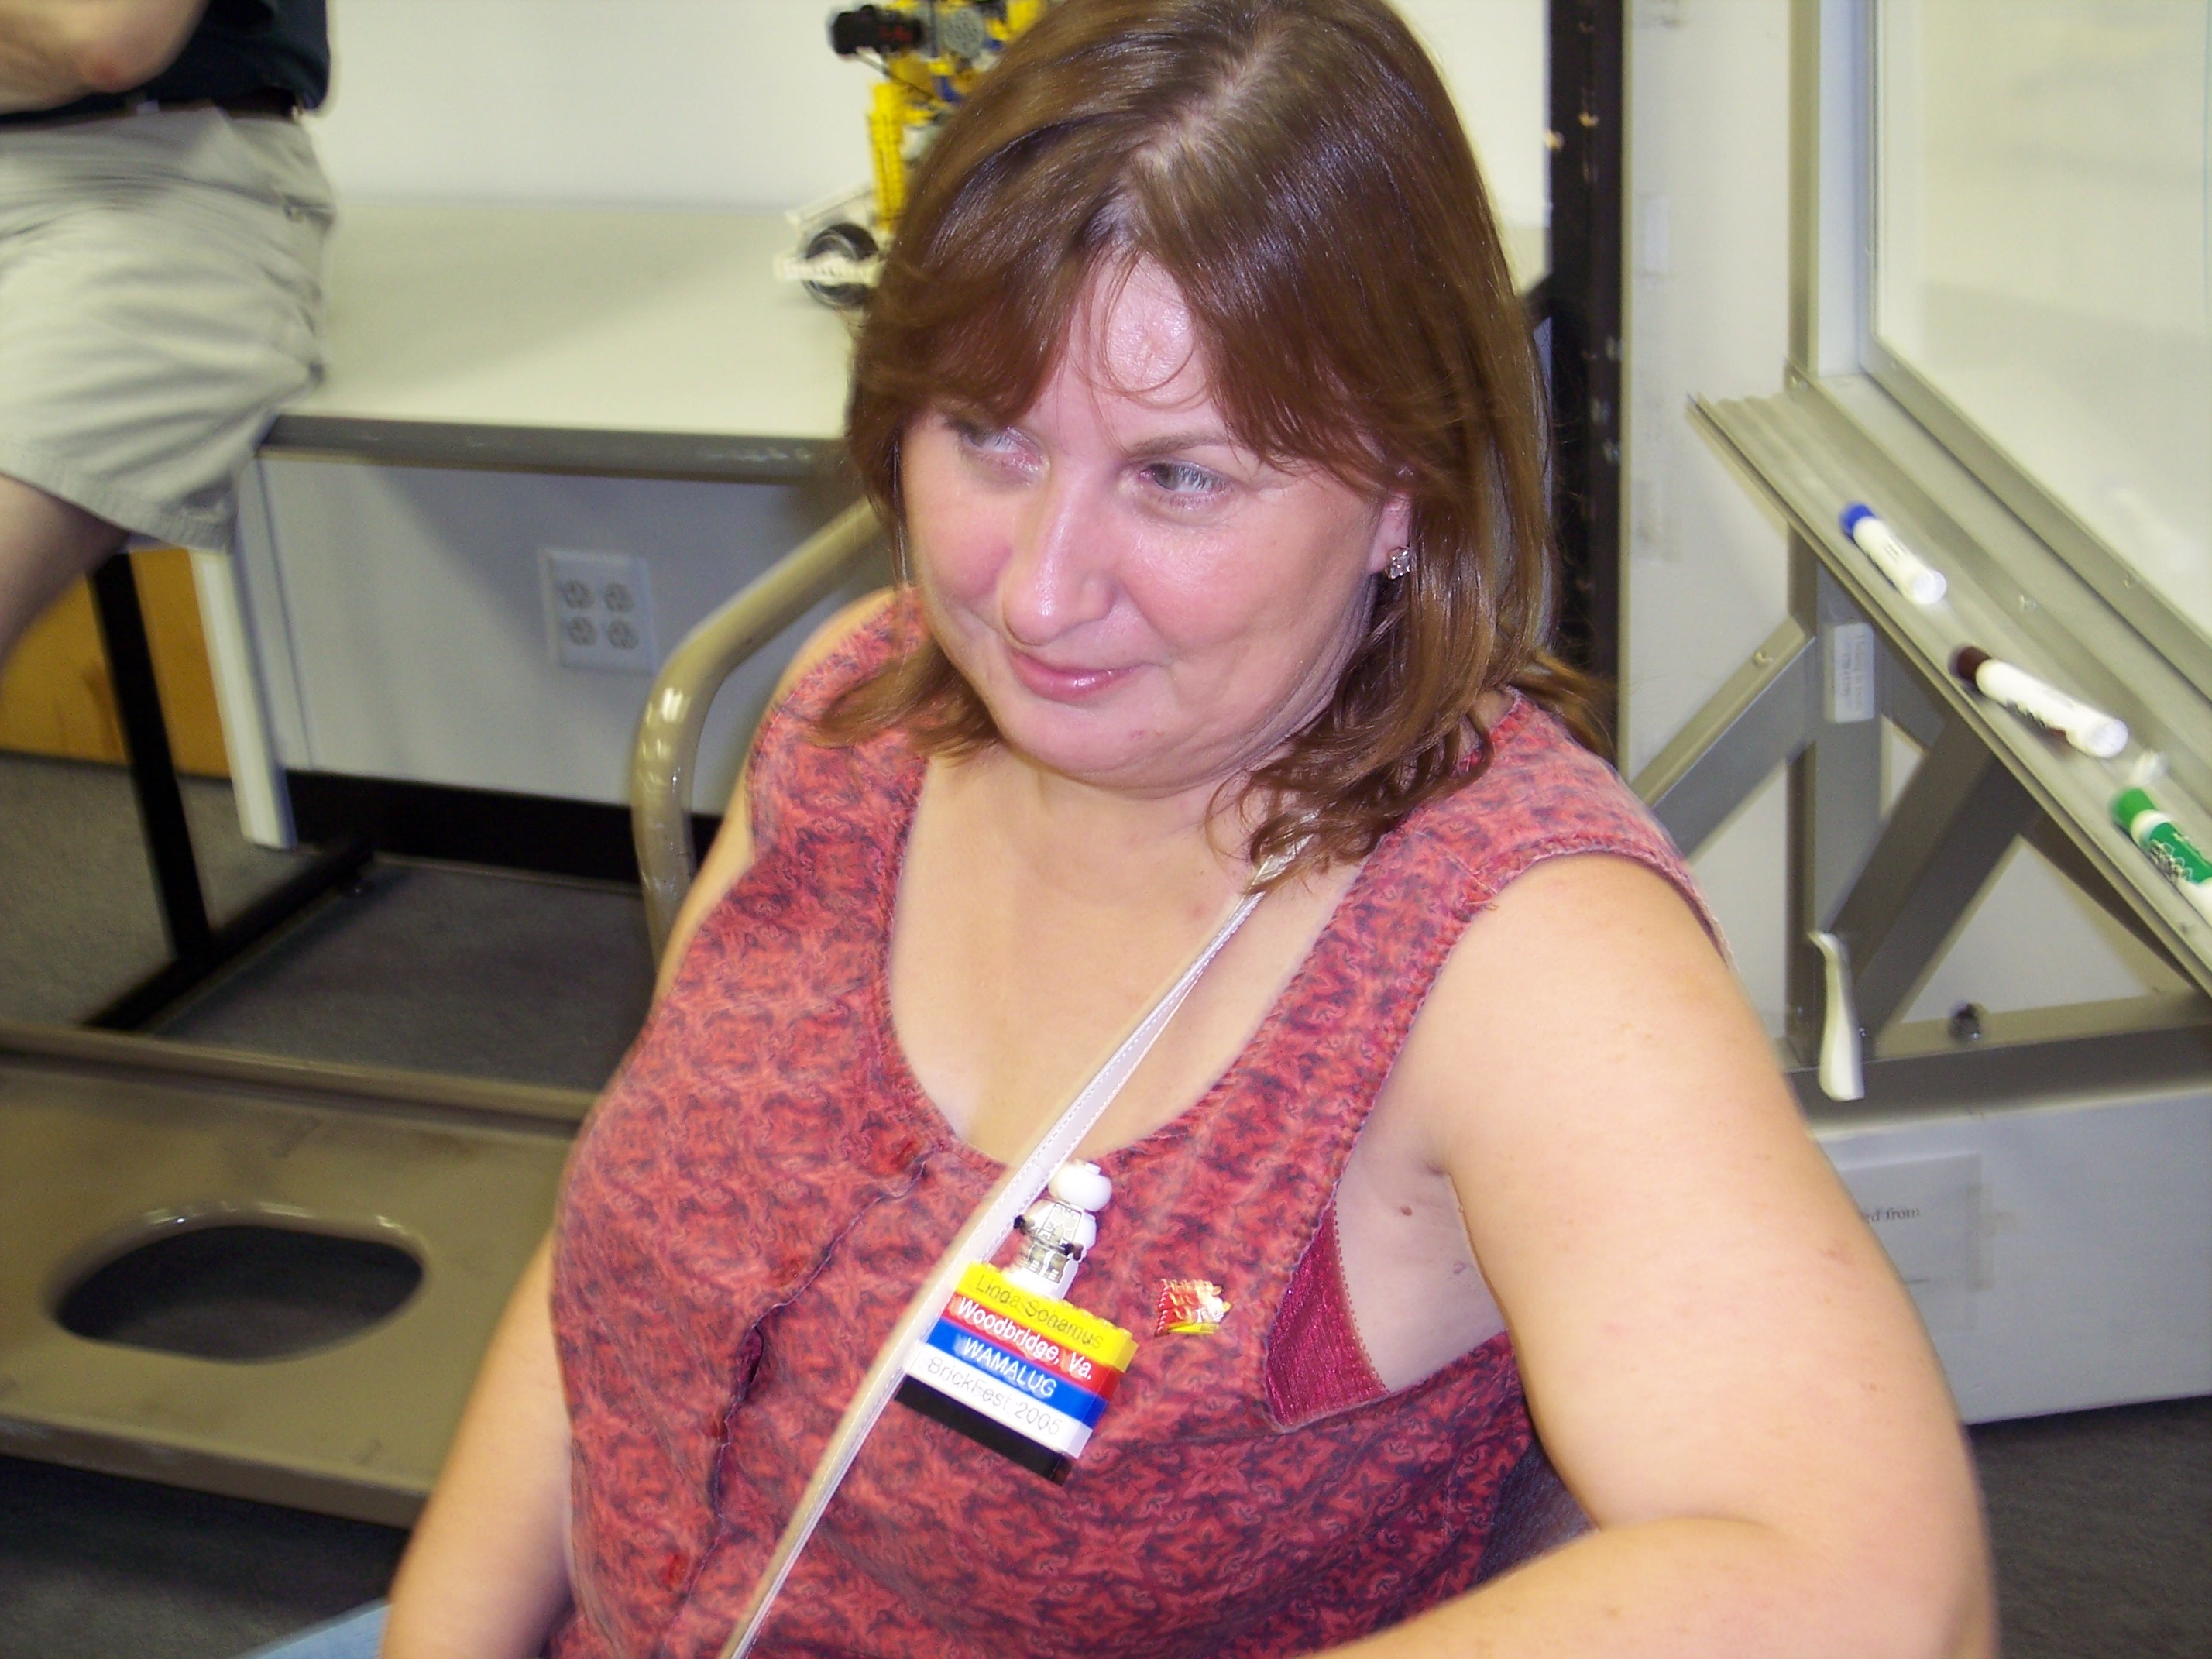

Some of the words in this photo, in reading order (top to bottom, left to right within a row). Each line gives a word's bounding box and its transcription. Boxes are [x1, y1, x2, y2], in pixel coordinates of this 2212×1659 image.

[1885, 1207, 1920, 1221] from
[974, 1274, 1023, 1307] Linda
[957, 1297, 1060, 1365] Woodbridge,
[1068, 1352, 1092, 1380] Va.
[963, 1337, 1058, 1399] WAMALUG
[926, 1356, 1012, 1411] BrickFest
[1013, 1402, 1063, 1435] 2005
